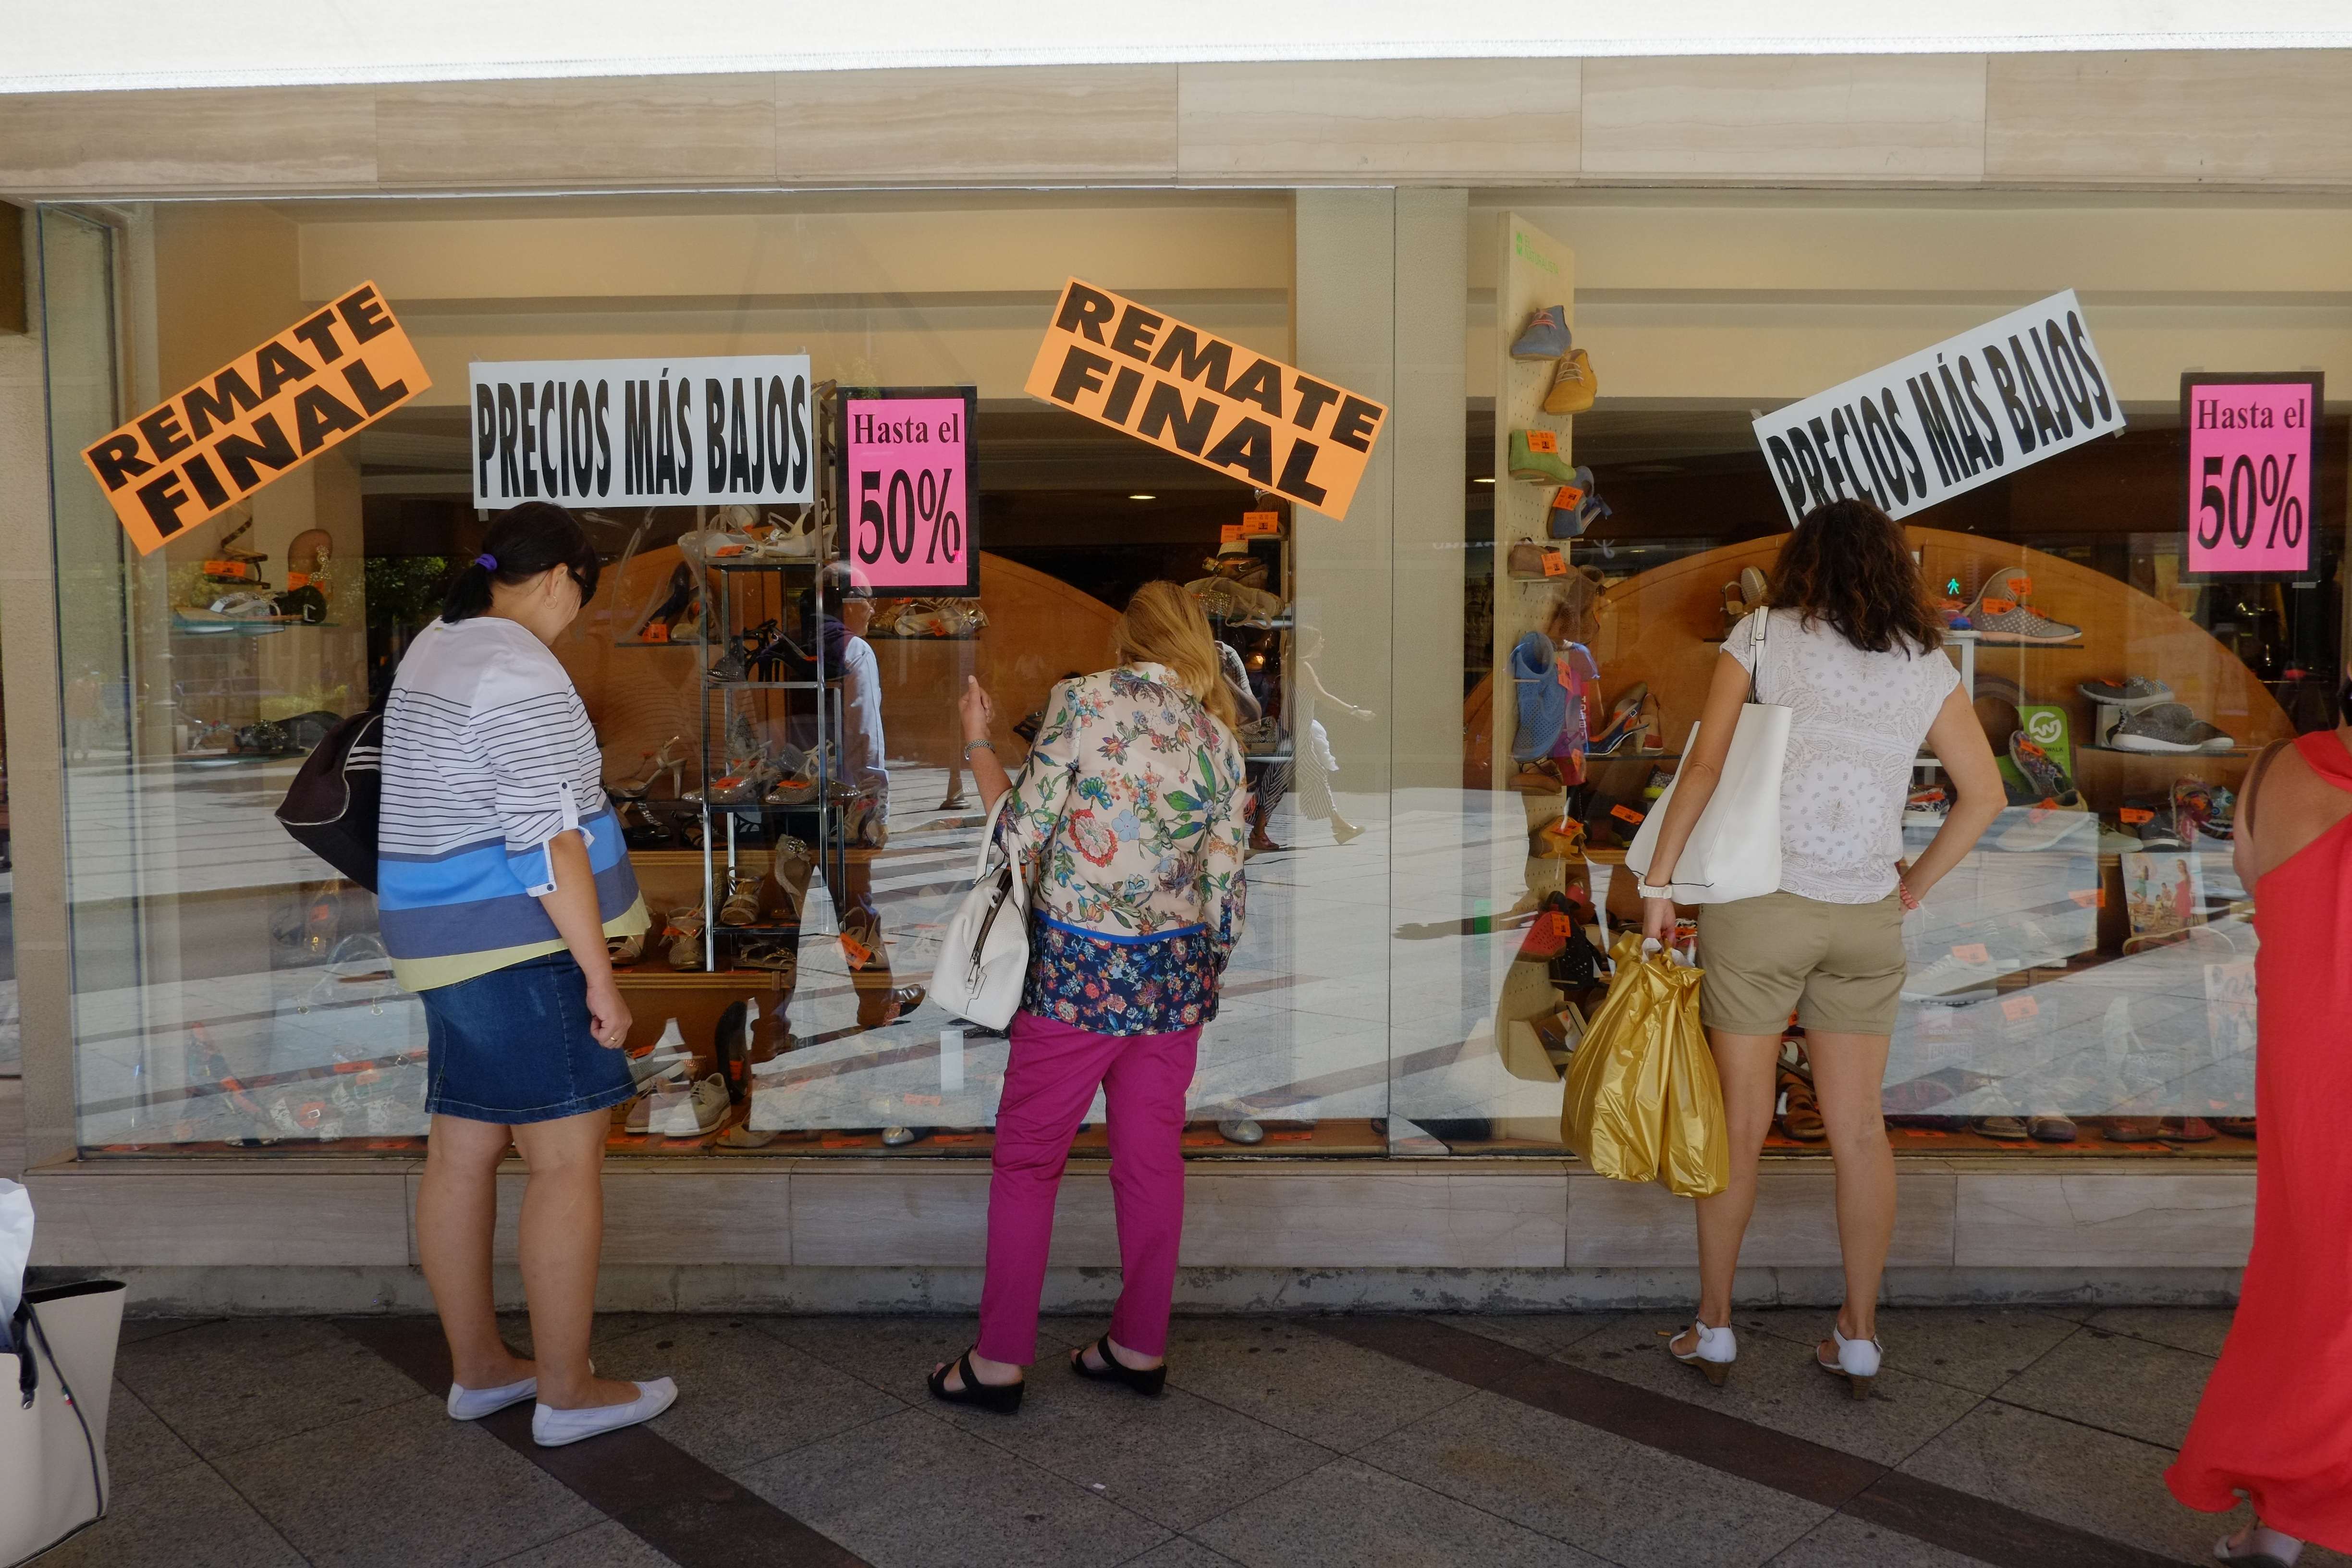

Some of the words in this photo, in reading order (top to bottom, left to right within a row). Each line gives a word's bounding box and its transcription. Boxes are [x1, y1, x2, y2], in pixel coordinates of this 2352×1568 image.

[88, 286, 394, 492] REMATE
[477, 379, 611, 498] PRECIOS
[625, 368, 693, 496] MÁS
[706, 375, 807, 494] BAJOS
[853, 414, 929, 443] Hasta
[938, 413, 960, 442] el
[1051, 345, 1326, 506] FINAL
[1056, 282, 1382, 453] REMATE
[1766, 387, 1927, 521] PRECIOS
[1906, 353, 2004, 487] MÁS
[1982, 311, 2112, 454] BAJOS
[2197, 400, 2274, 429] Hasta
[2284, 399, 2305, 428] el
[136, 359, 408, 538] FINAL
[858, 469, 960, 564] 50%
[2198, 454, 2302, 549] 50%
